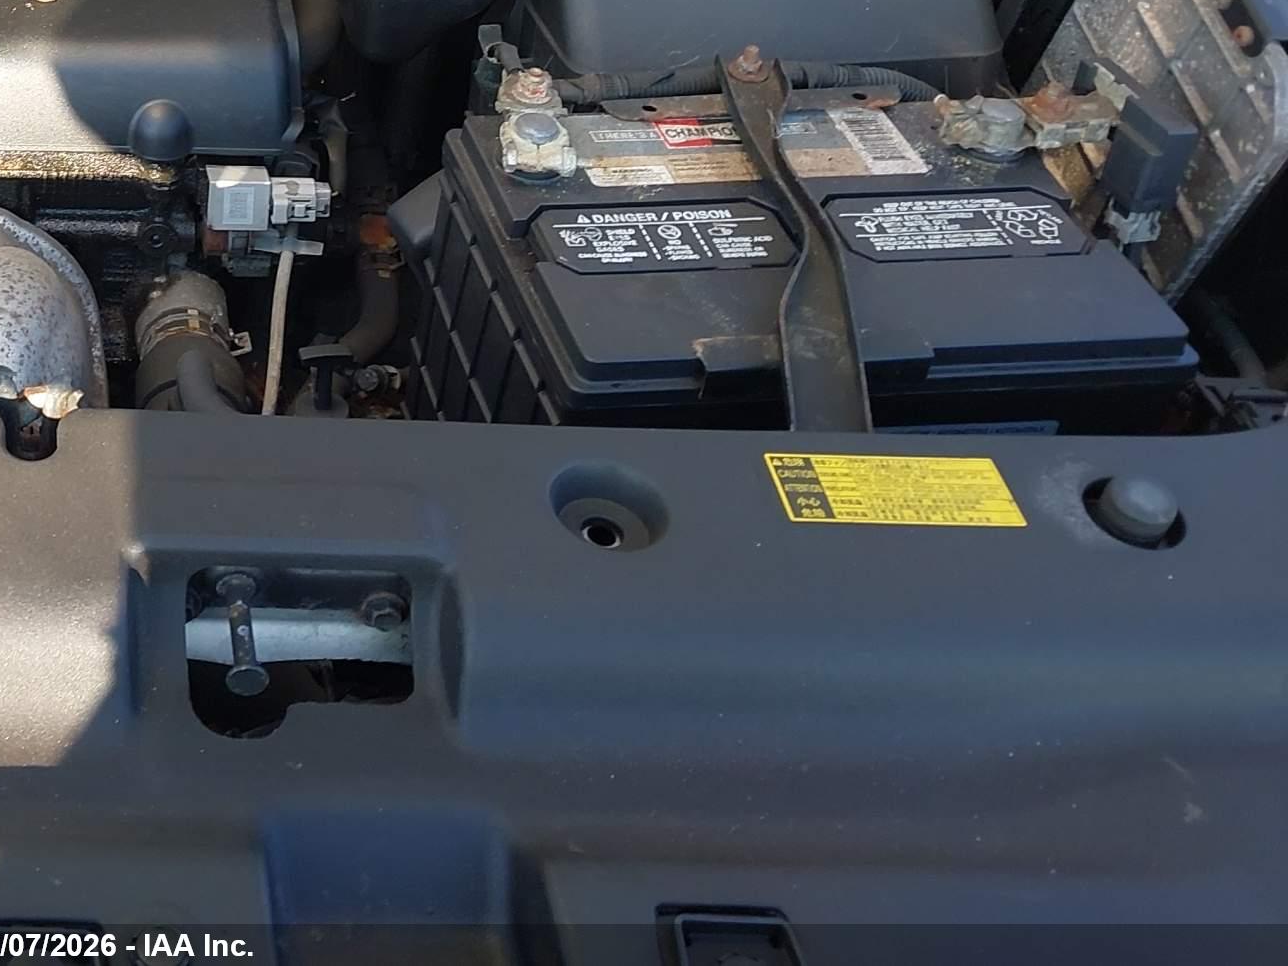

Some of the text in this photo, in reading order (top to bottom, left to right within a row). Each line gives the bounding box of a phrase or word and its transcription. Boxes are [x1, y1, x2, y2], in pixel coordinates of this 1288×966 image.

[665, 126, 737, 139] CHAMPIO
[591, 213, 658, 224] DANGER
[672, 209, 732, 221] POISON
[776, 469, 817, 478] CAUTION
